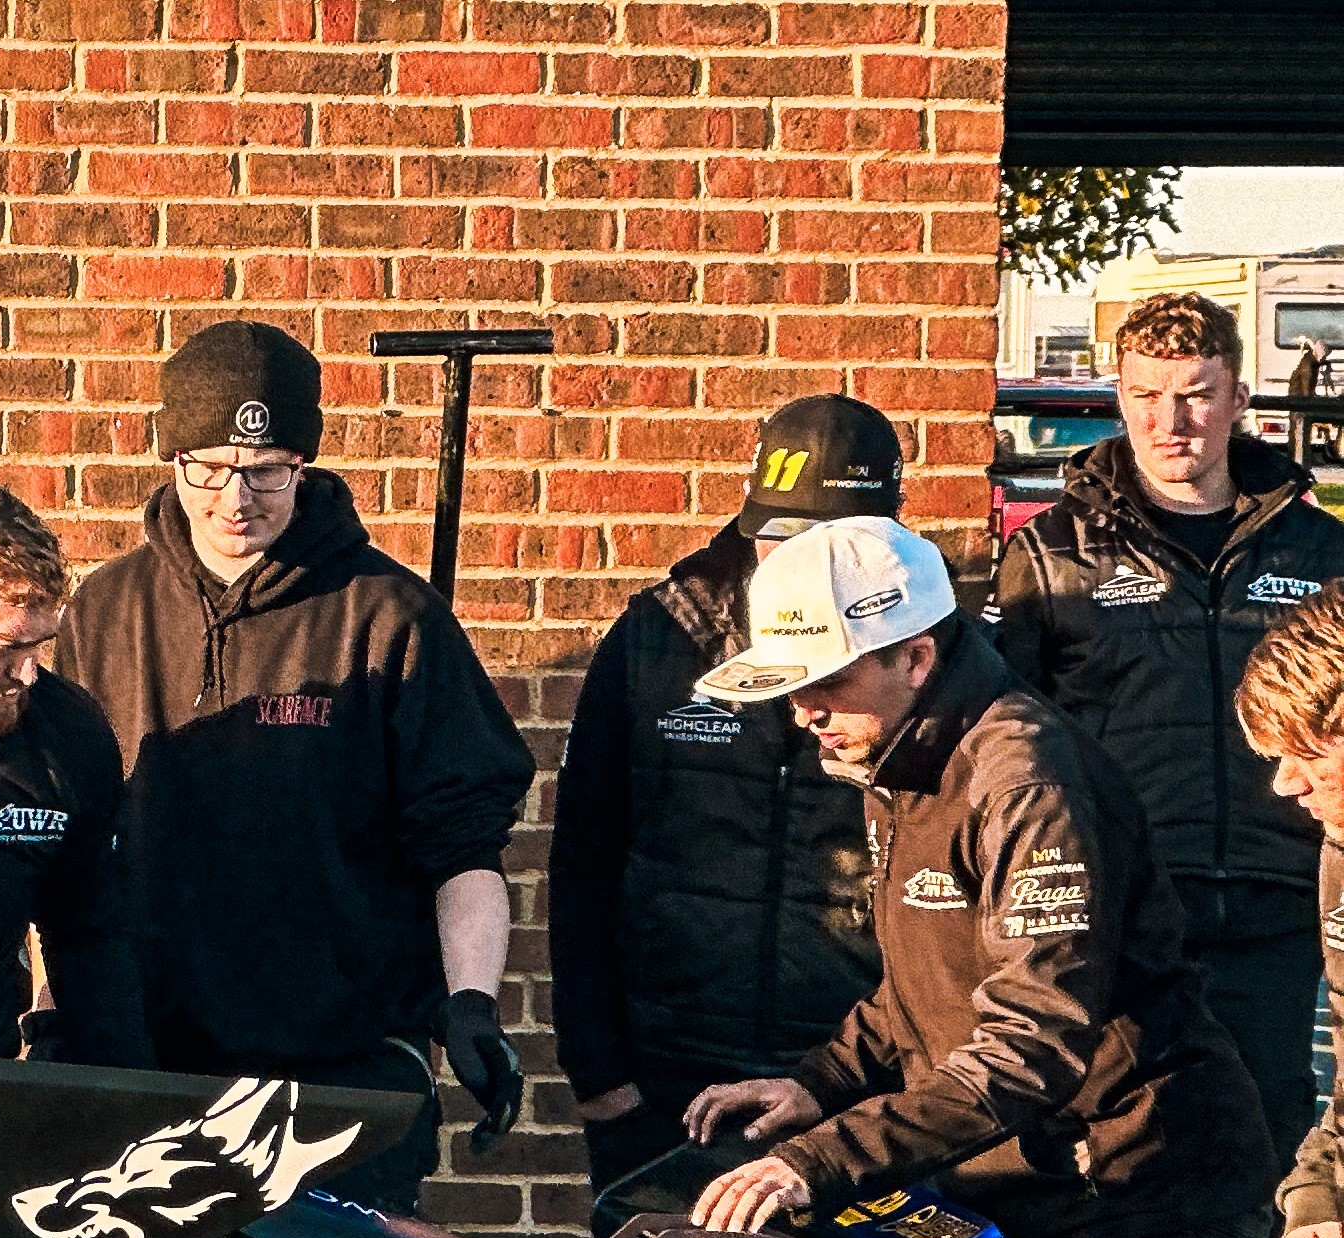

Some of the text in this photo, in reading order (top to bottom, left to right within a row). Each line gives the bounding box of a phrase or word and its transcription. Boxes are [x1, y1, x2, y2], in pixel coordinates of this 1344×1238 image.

[762, 447, 810, 492] 11
[1093, 581, 1166, 600] HIGHCLEAR
[255, 695, 333, 727] SCARFACE
[657, 718, 742, 734] HIGHCLEAR
[13, 807, 69, 832] UWR
